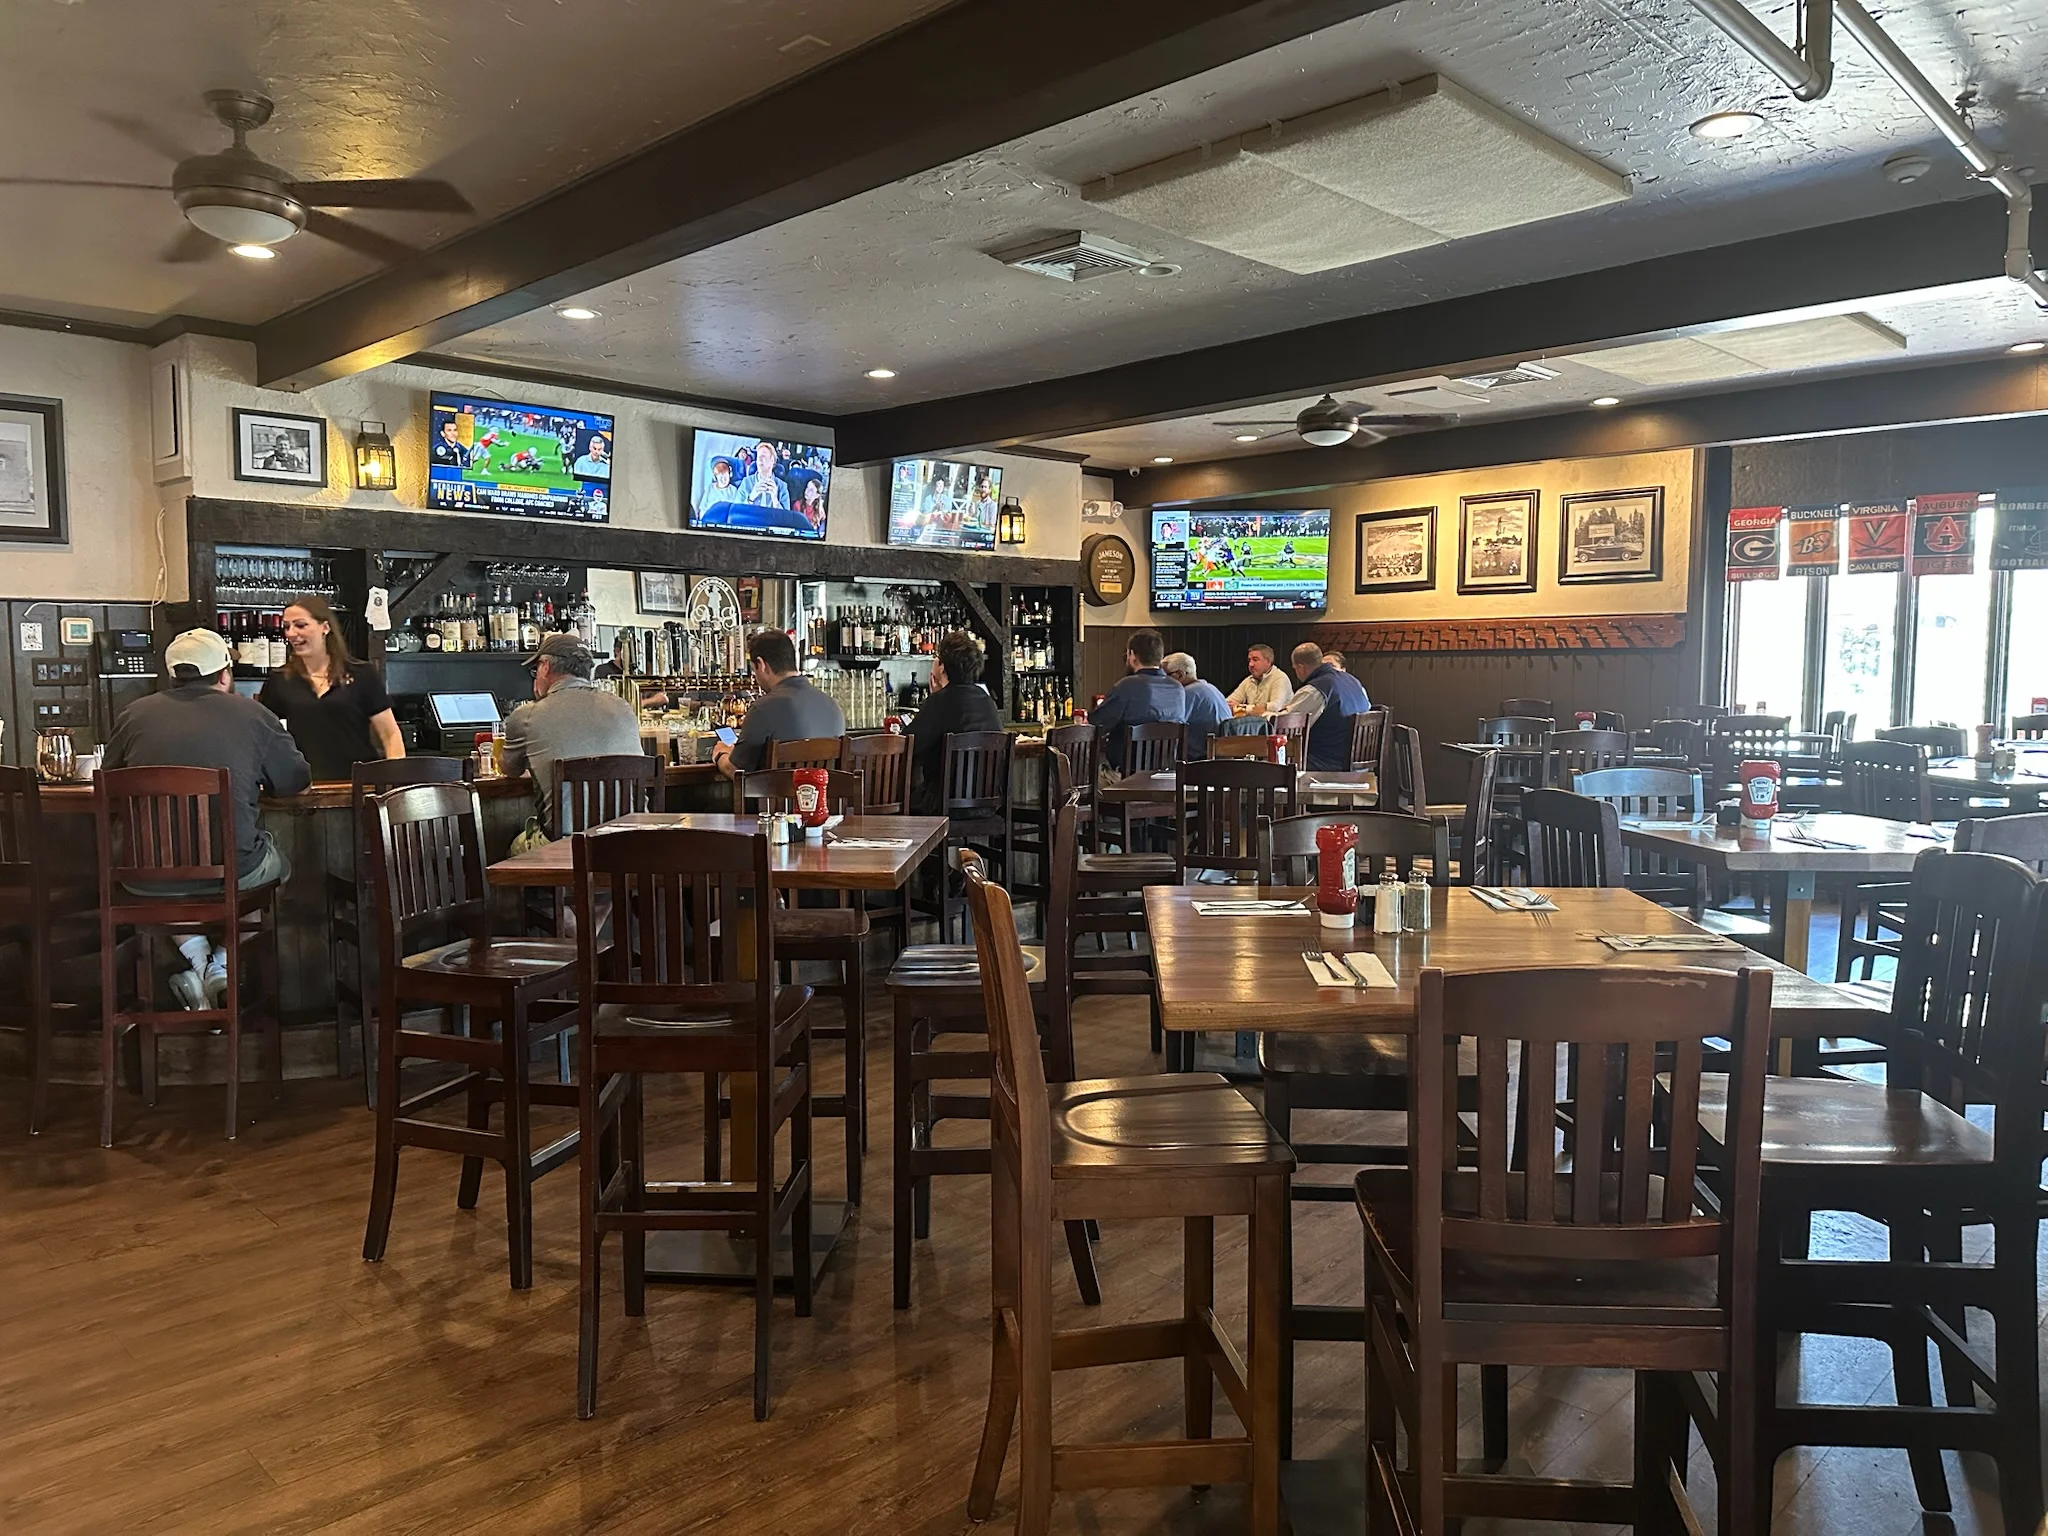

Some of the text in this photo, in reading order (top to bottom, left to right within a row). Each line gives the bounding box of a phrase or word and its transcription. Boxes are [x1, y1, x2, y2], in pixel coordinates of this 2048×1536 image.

[437, 489, 472, 502] NEWS
[1852, 505, 1899, 515] VIRGINIA
[1923, 500, 1974, 511] AUBURN
[1790, 509, 1839, 520] BUCKNELL
[1734, 518, 1777, 527] GEORGIA
[1098, 550, 1124, 560] JAMESON
[1848, 561, 1900, 571] CAVALIERS
[1919, 561, 1971, 570] TIGERS
[1731, 571, 1777, 580] BULLDOGS
